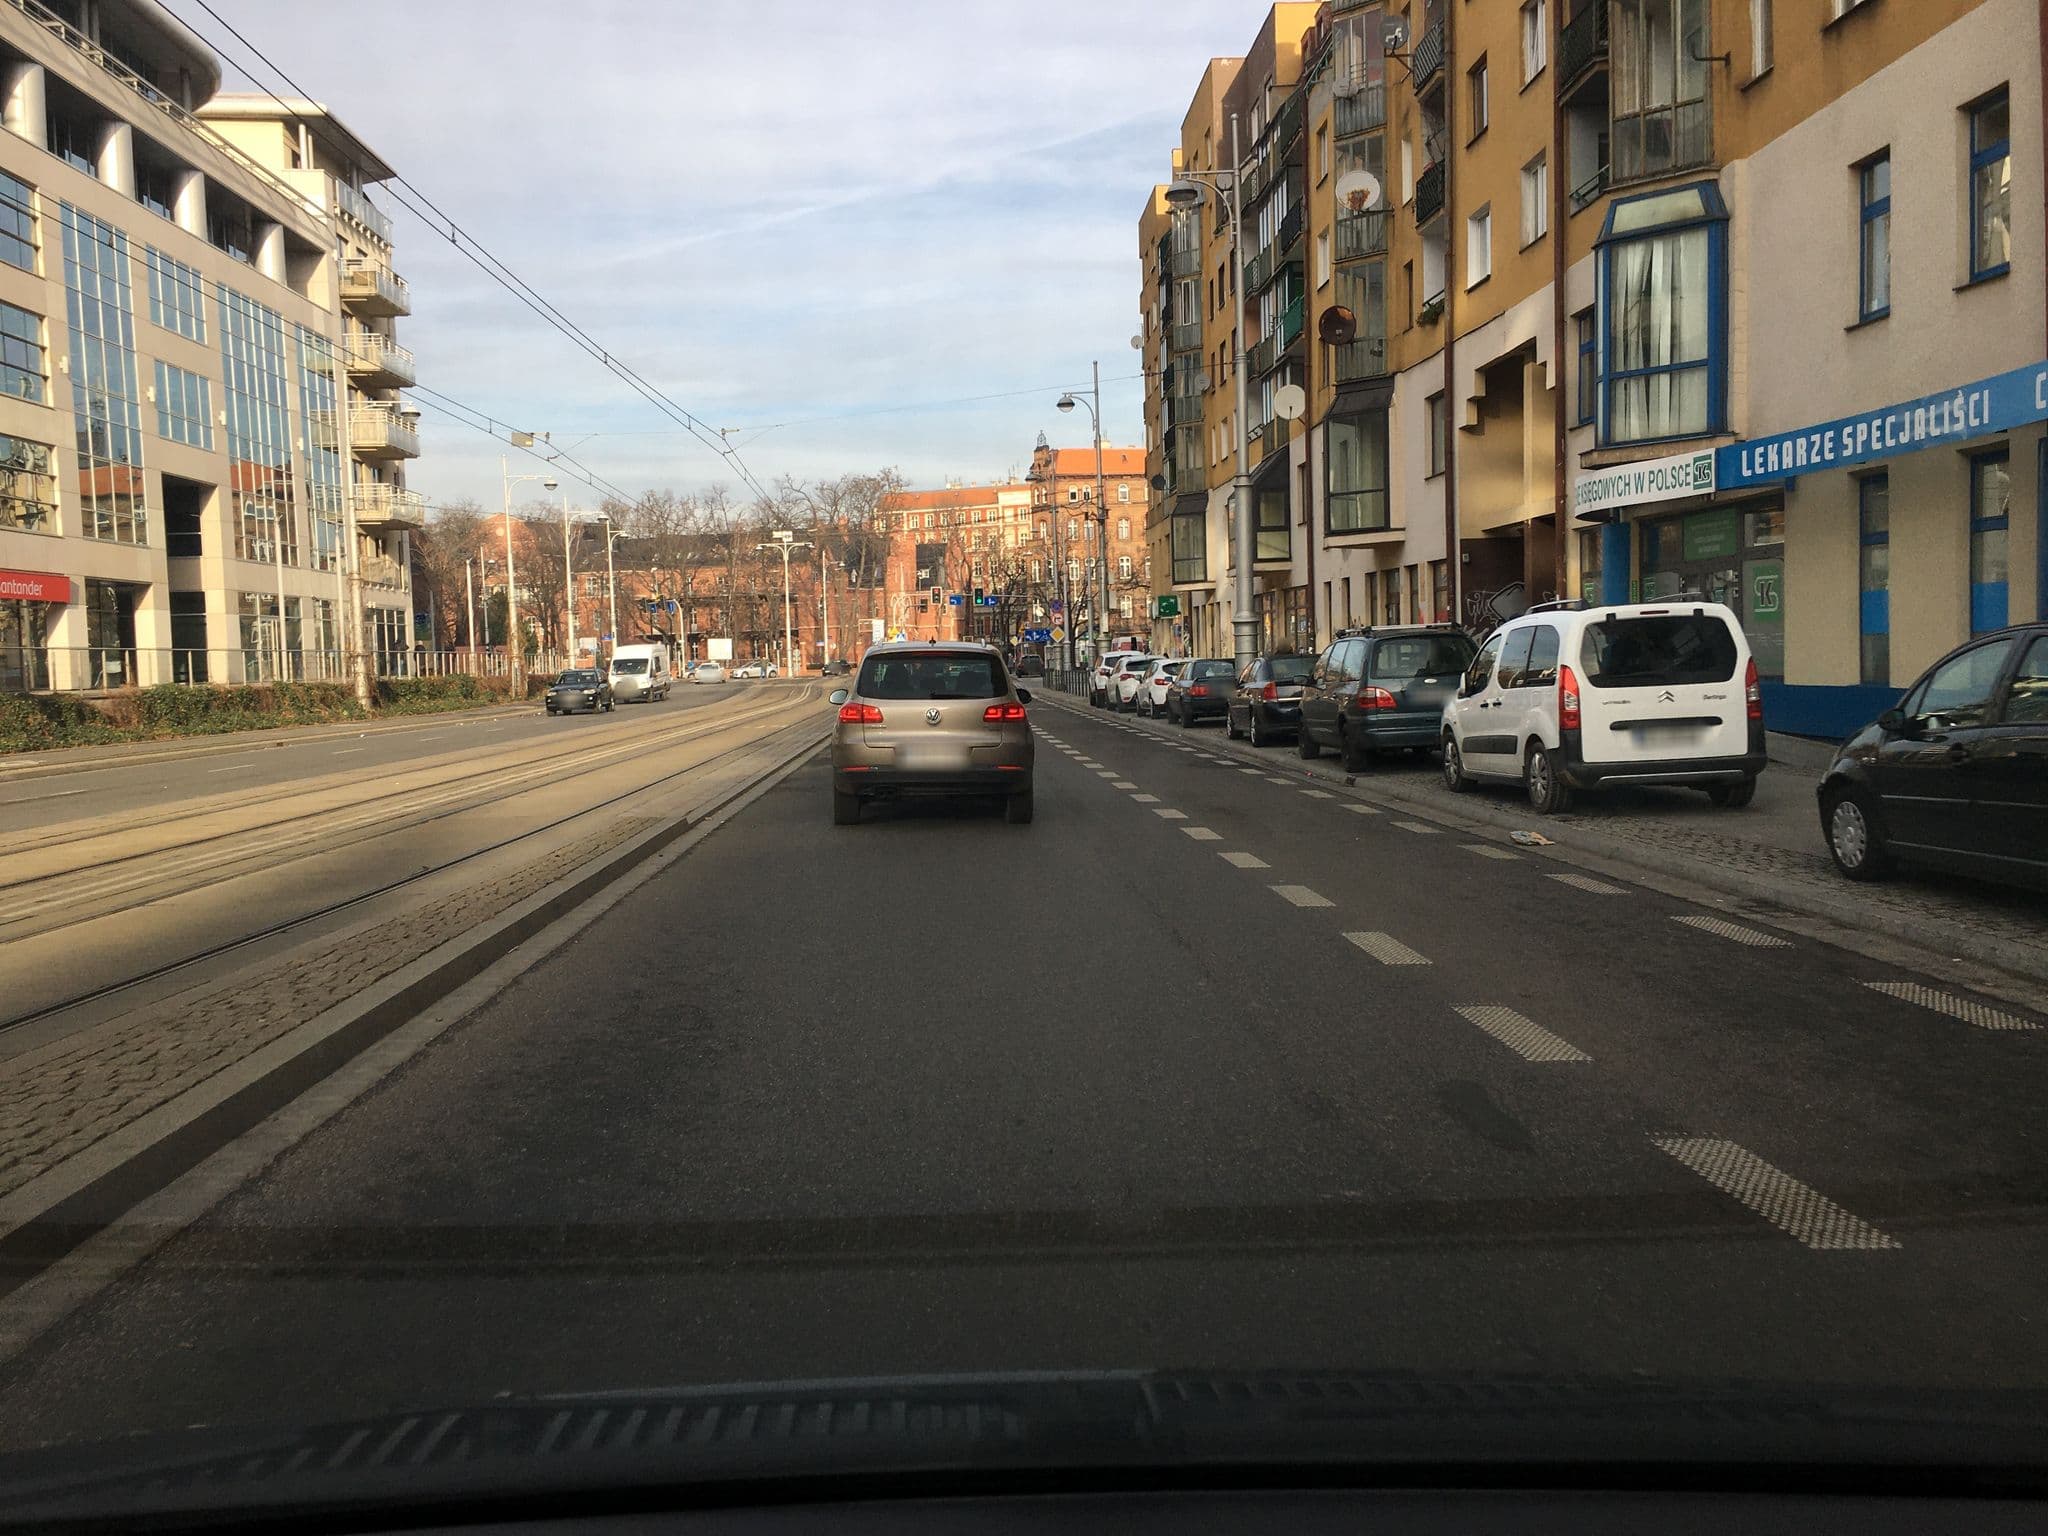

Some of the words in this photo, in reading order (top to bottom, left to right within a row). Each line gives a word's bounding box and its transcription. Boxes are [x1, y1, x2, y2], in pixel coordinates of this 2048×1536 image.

[1741, 430, 1835, 477] LEKARZE
[1842, 389, 1990, 457] SPECJALIŚCI
[1634, 471, 1646, 494] W
[1648, 463, 1691, 492] POLSCE
[0, 579, 43, 596] antander
